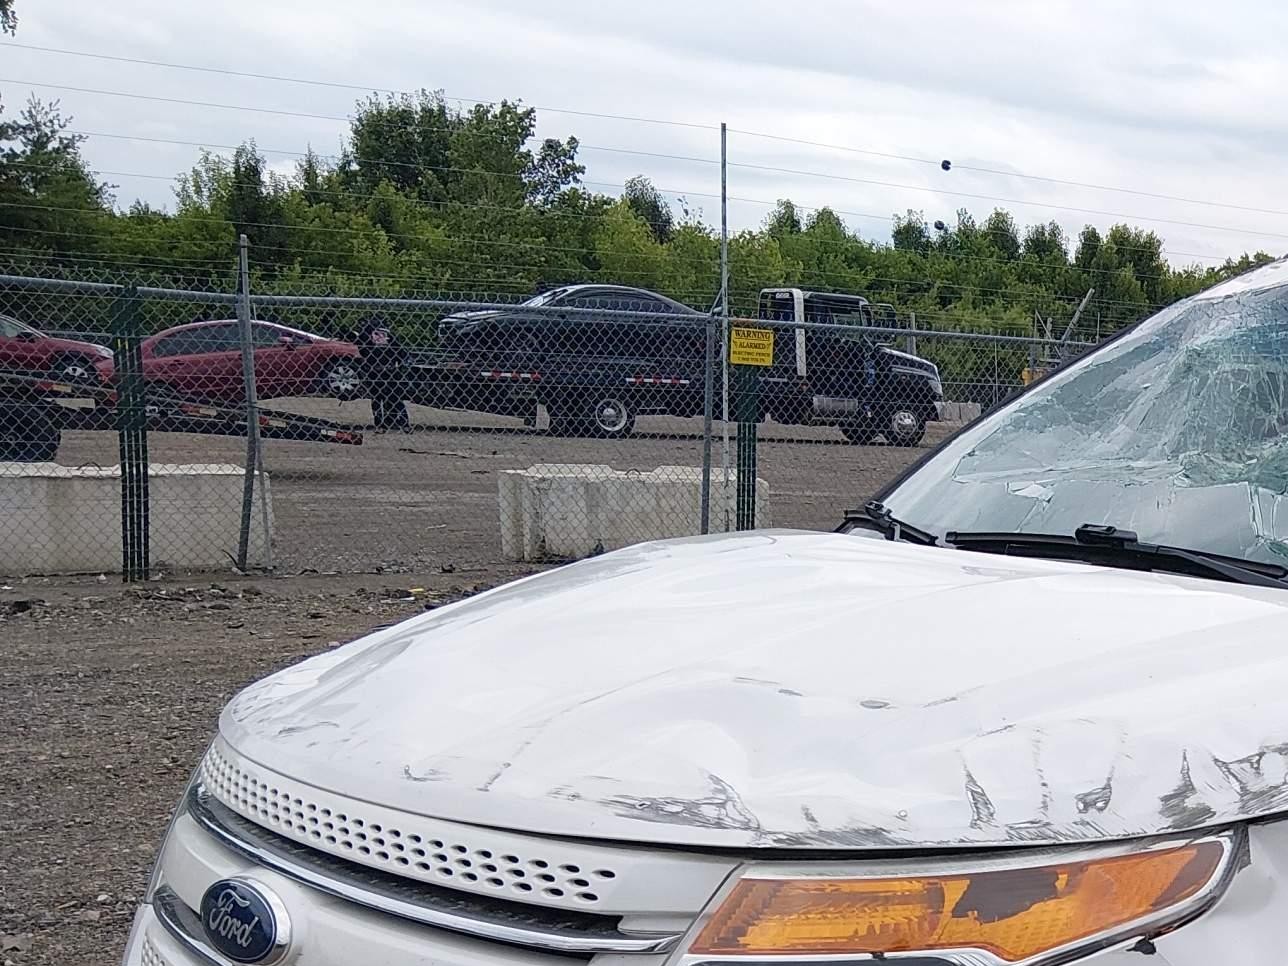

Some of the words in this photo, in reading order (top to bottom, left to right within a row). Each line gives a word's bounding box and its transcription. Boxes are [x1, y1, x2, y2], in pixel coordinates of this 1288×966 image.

[734, 329, 770, 340] WARNING
[738, 342, 766, 350] ALARMED
[208, 888, 251, 948] Ford
